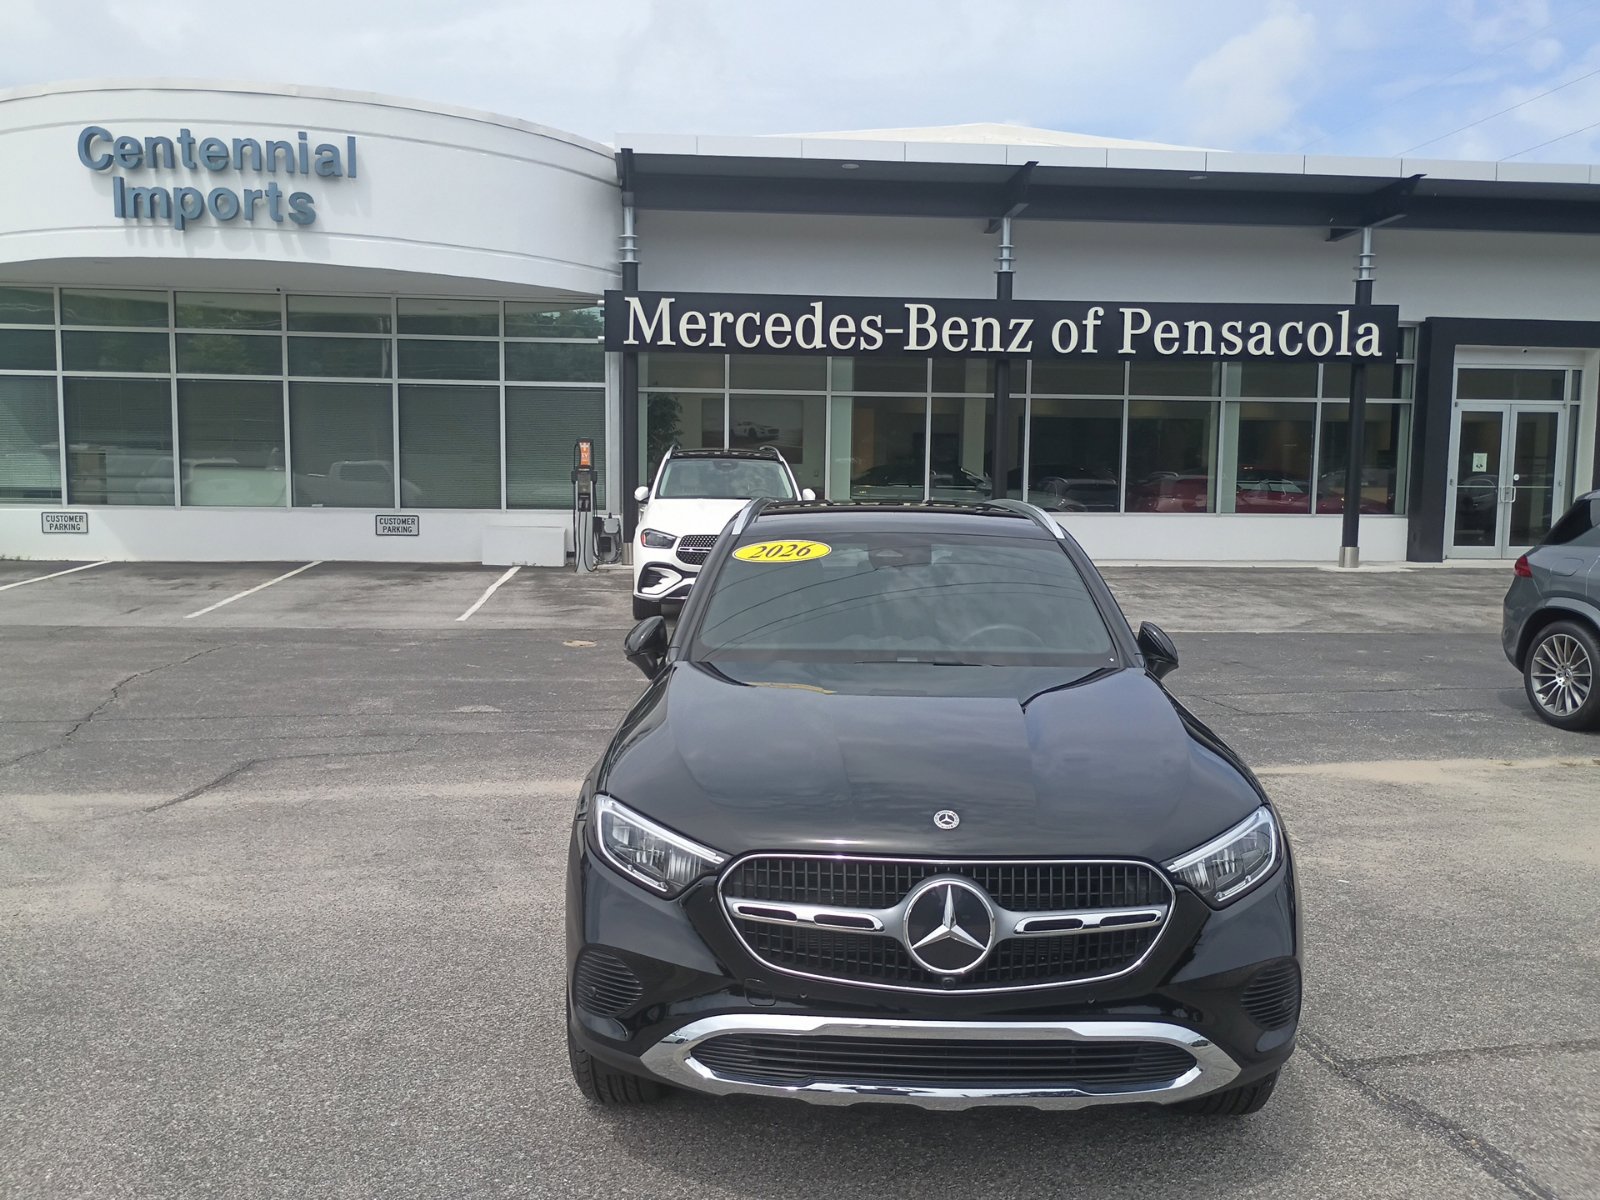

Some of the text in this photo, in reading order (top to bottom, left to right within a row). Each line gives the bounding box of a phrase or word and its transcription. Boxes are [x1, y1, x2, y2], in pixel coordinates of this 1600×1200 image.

[77, 126, 357, 178] Centennial
[113, 176, 317, 231] Imports
[623, 296, 1383, 357] Mercedes-Benz of Pensacola
[45, 515, 84, 523] CUSTOMER
[379, 517, 416, 525] CUSTOMER
[49, 523, 81, 531] PARKING
[382, 525, 413, 533] PARKING
[747, 543, 816, 559] 2026
